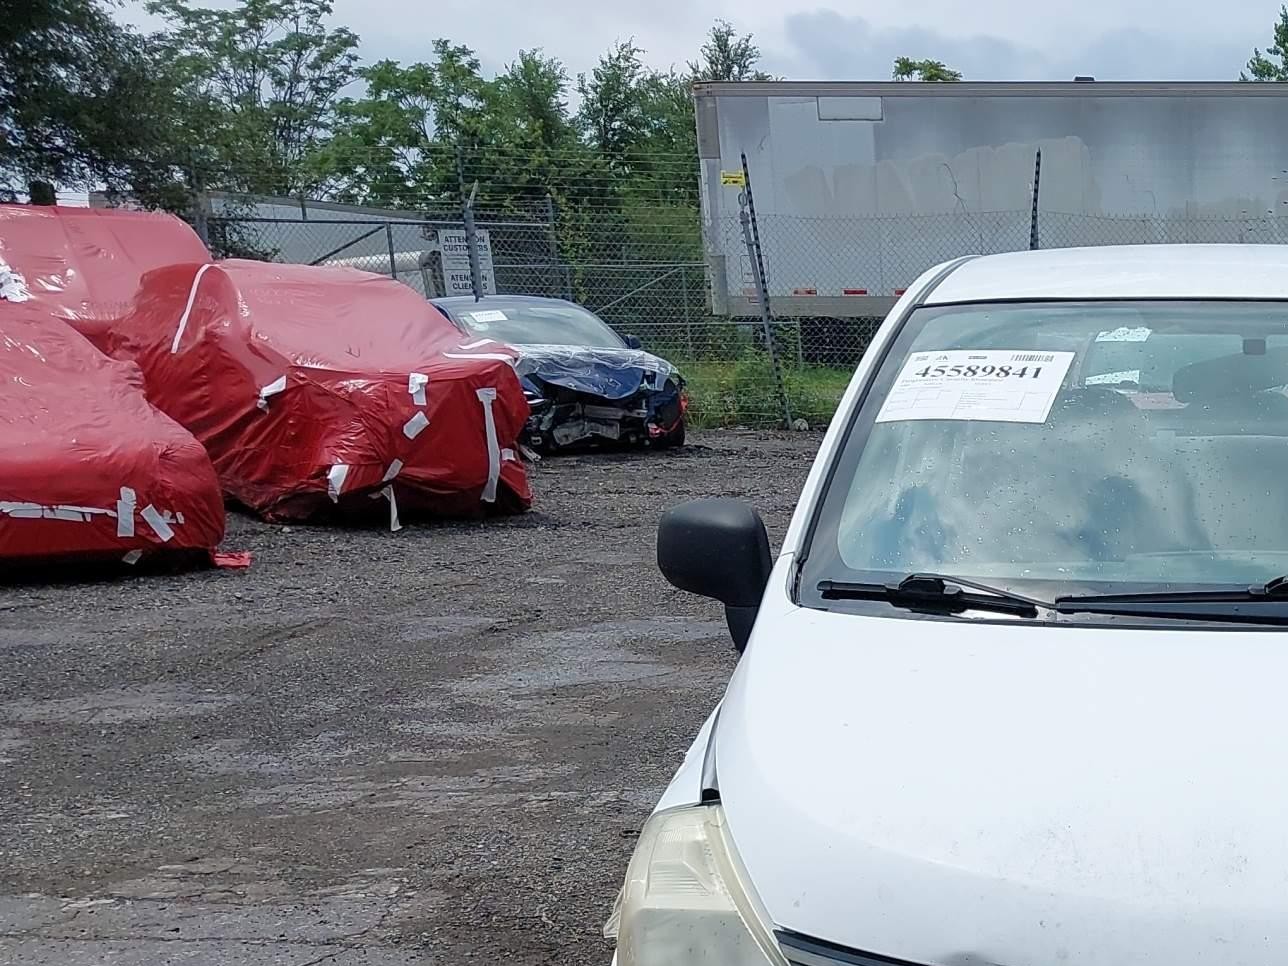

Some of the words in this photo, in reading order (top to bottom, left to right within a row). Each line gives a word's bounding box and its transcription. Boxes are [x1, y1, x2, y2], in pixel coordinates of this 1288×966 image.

[444, 235, 485, 243] ATTENON
[443, 244, 489, 252] CUSTORS
[450, 274, 488, 282] ATENN
[452, 282, 488, 290] CLIENS
[914, 364, 1043, 379] 45589841
